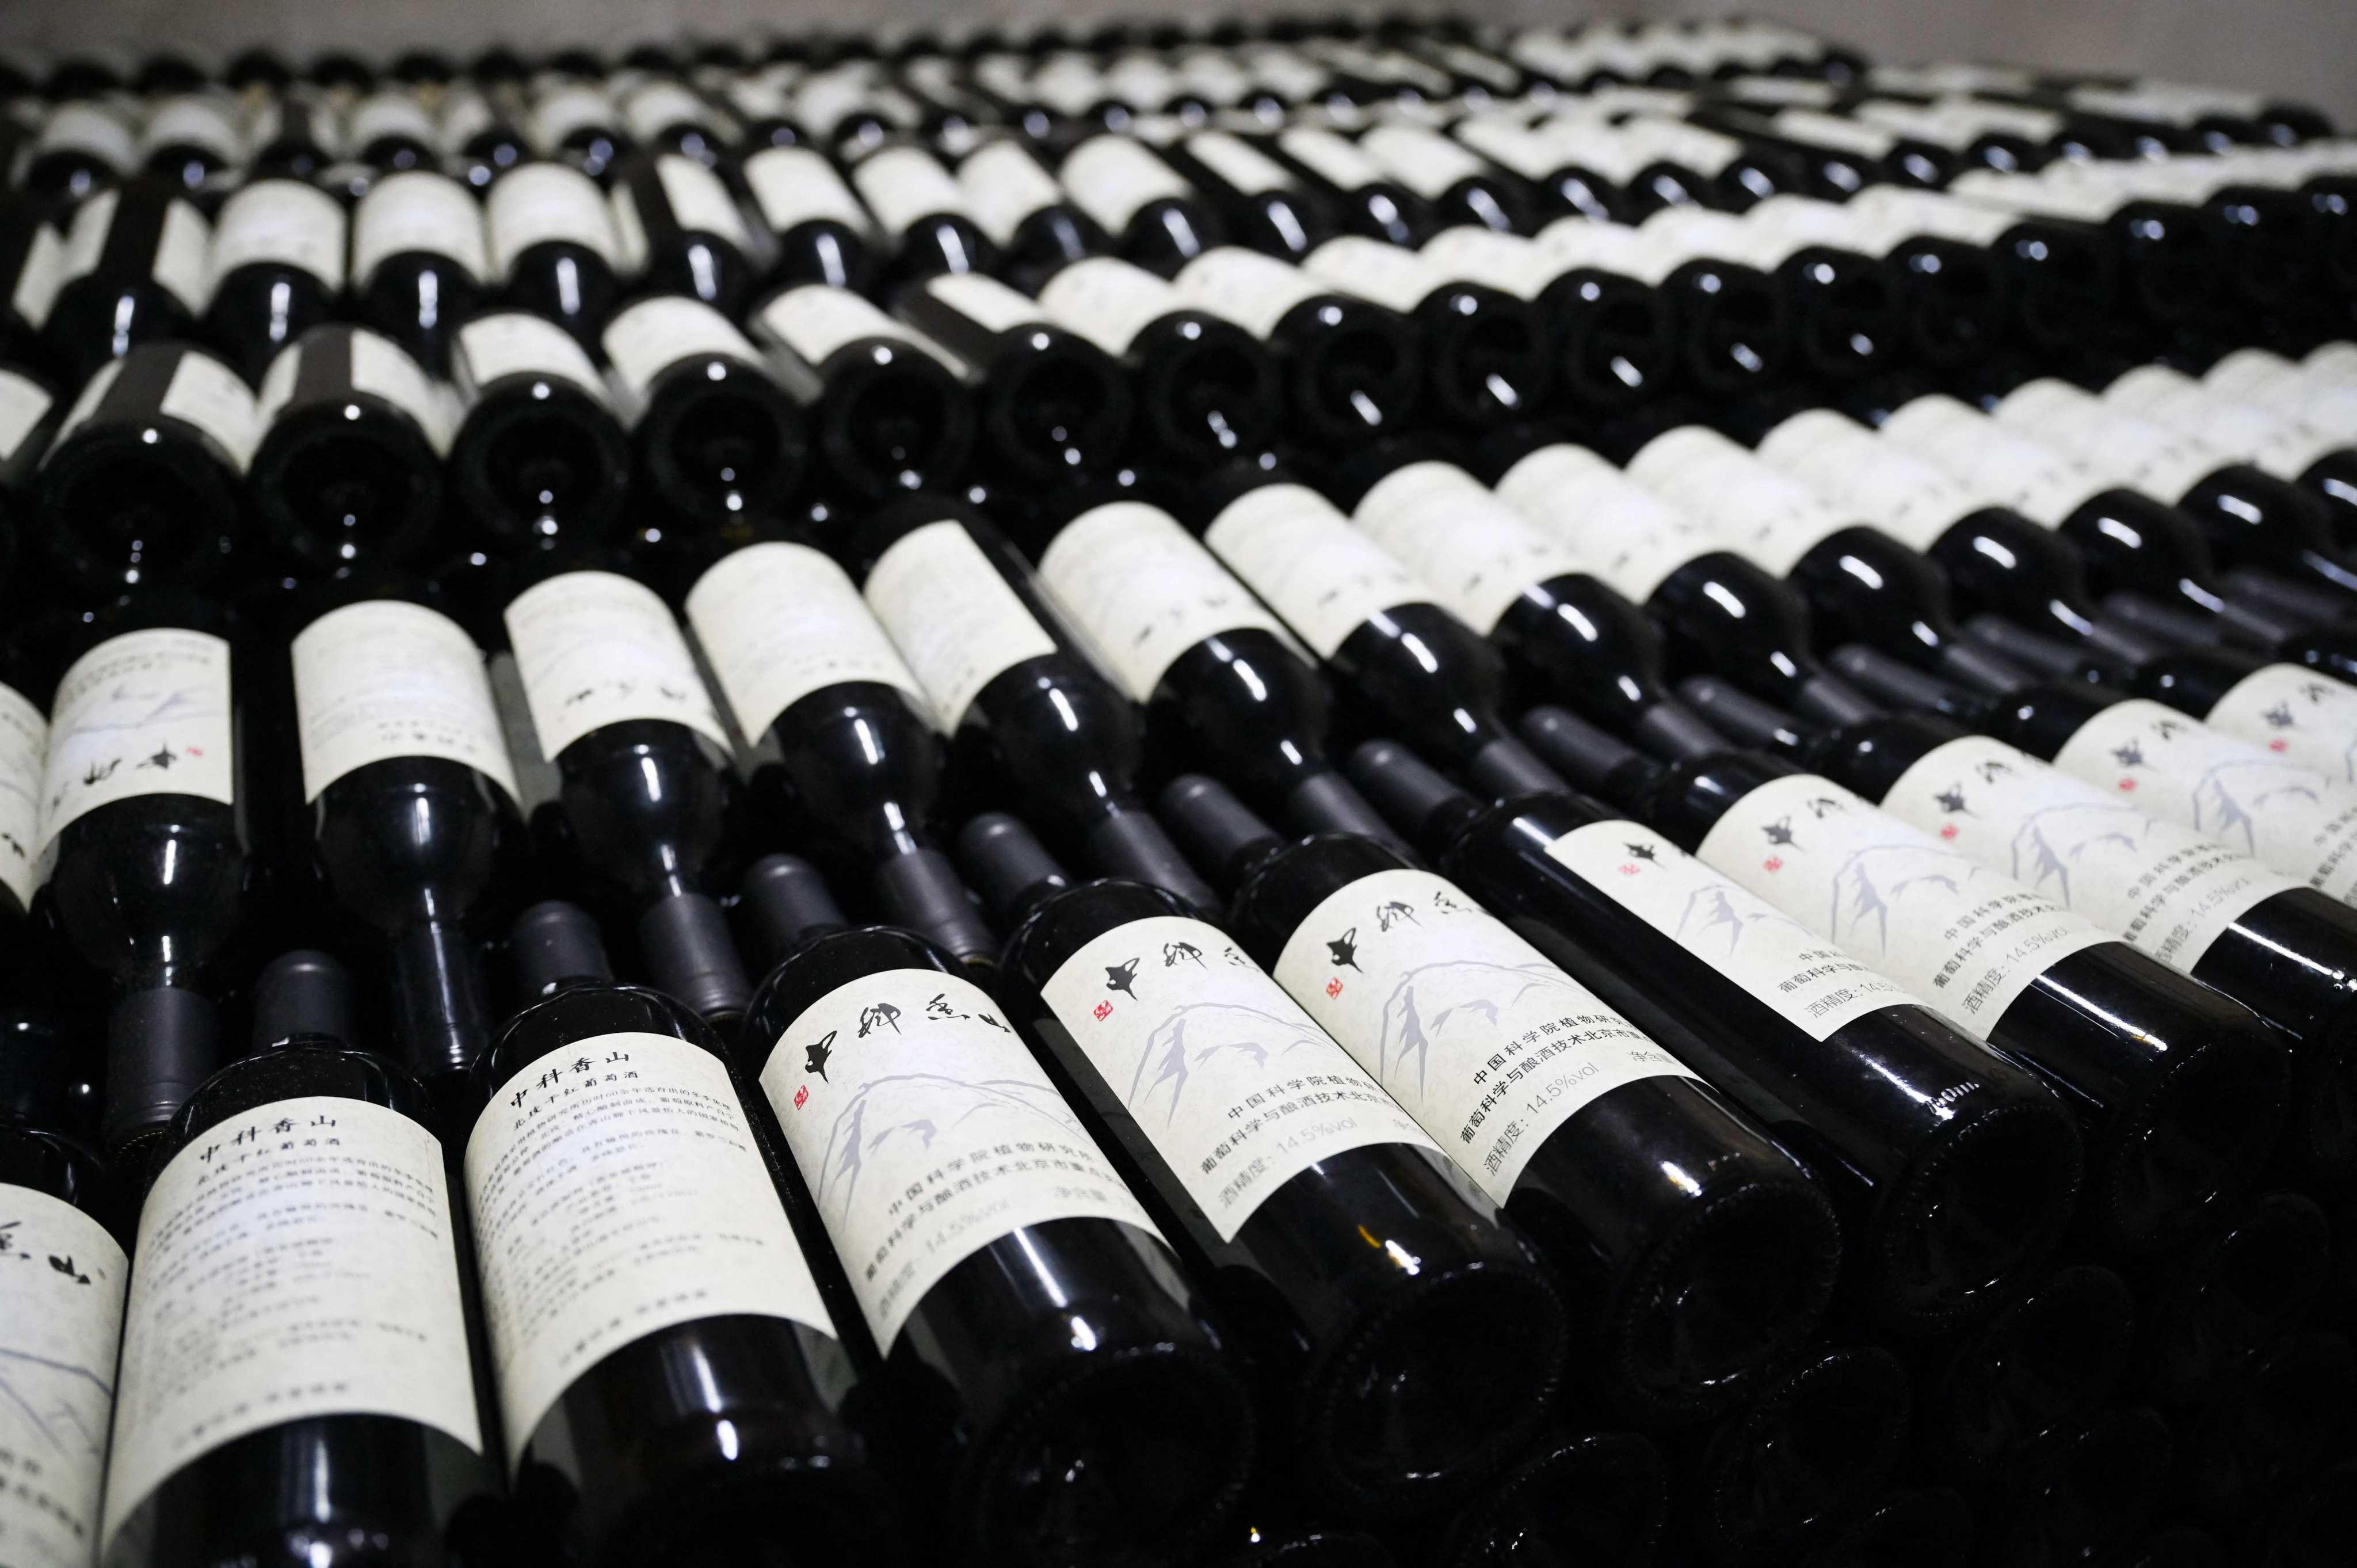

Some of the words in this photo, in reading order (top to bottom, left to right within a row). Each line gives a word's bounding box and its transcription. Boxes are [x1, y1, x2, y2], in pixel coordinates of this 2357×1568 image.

[510, 1051, 630, 1108] 中科香山
[199, 1115, 338, 1163] 中科香山
